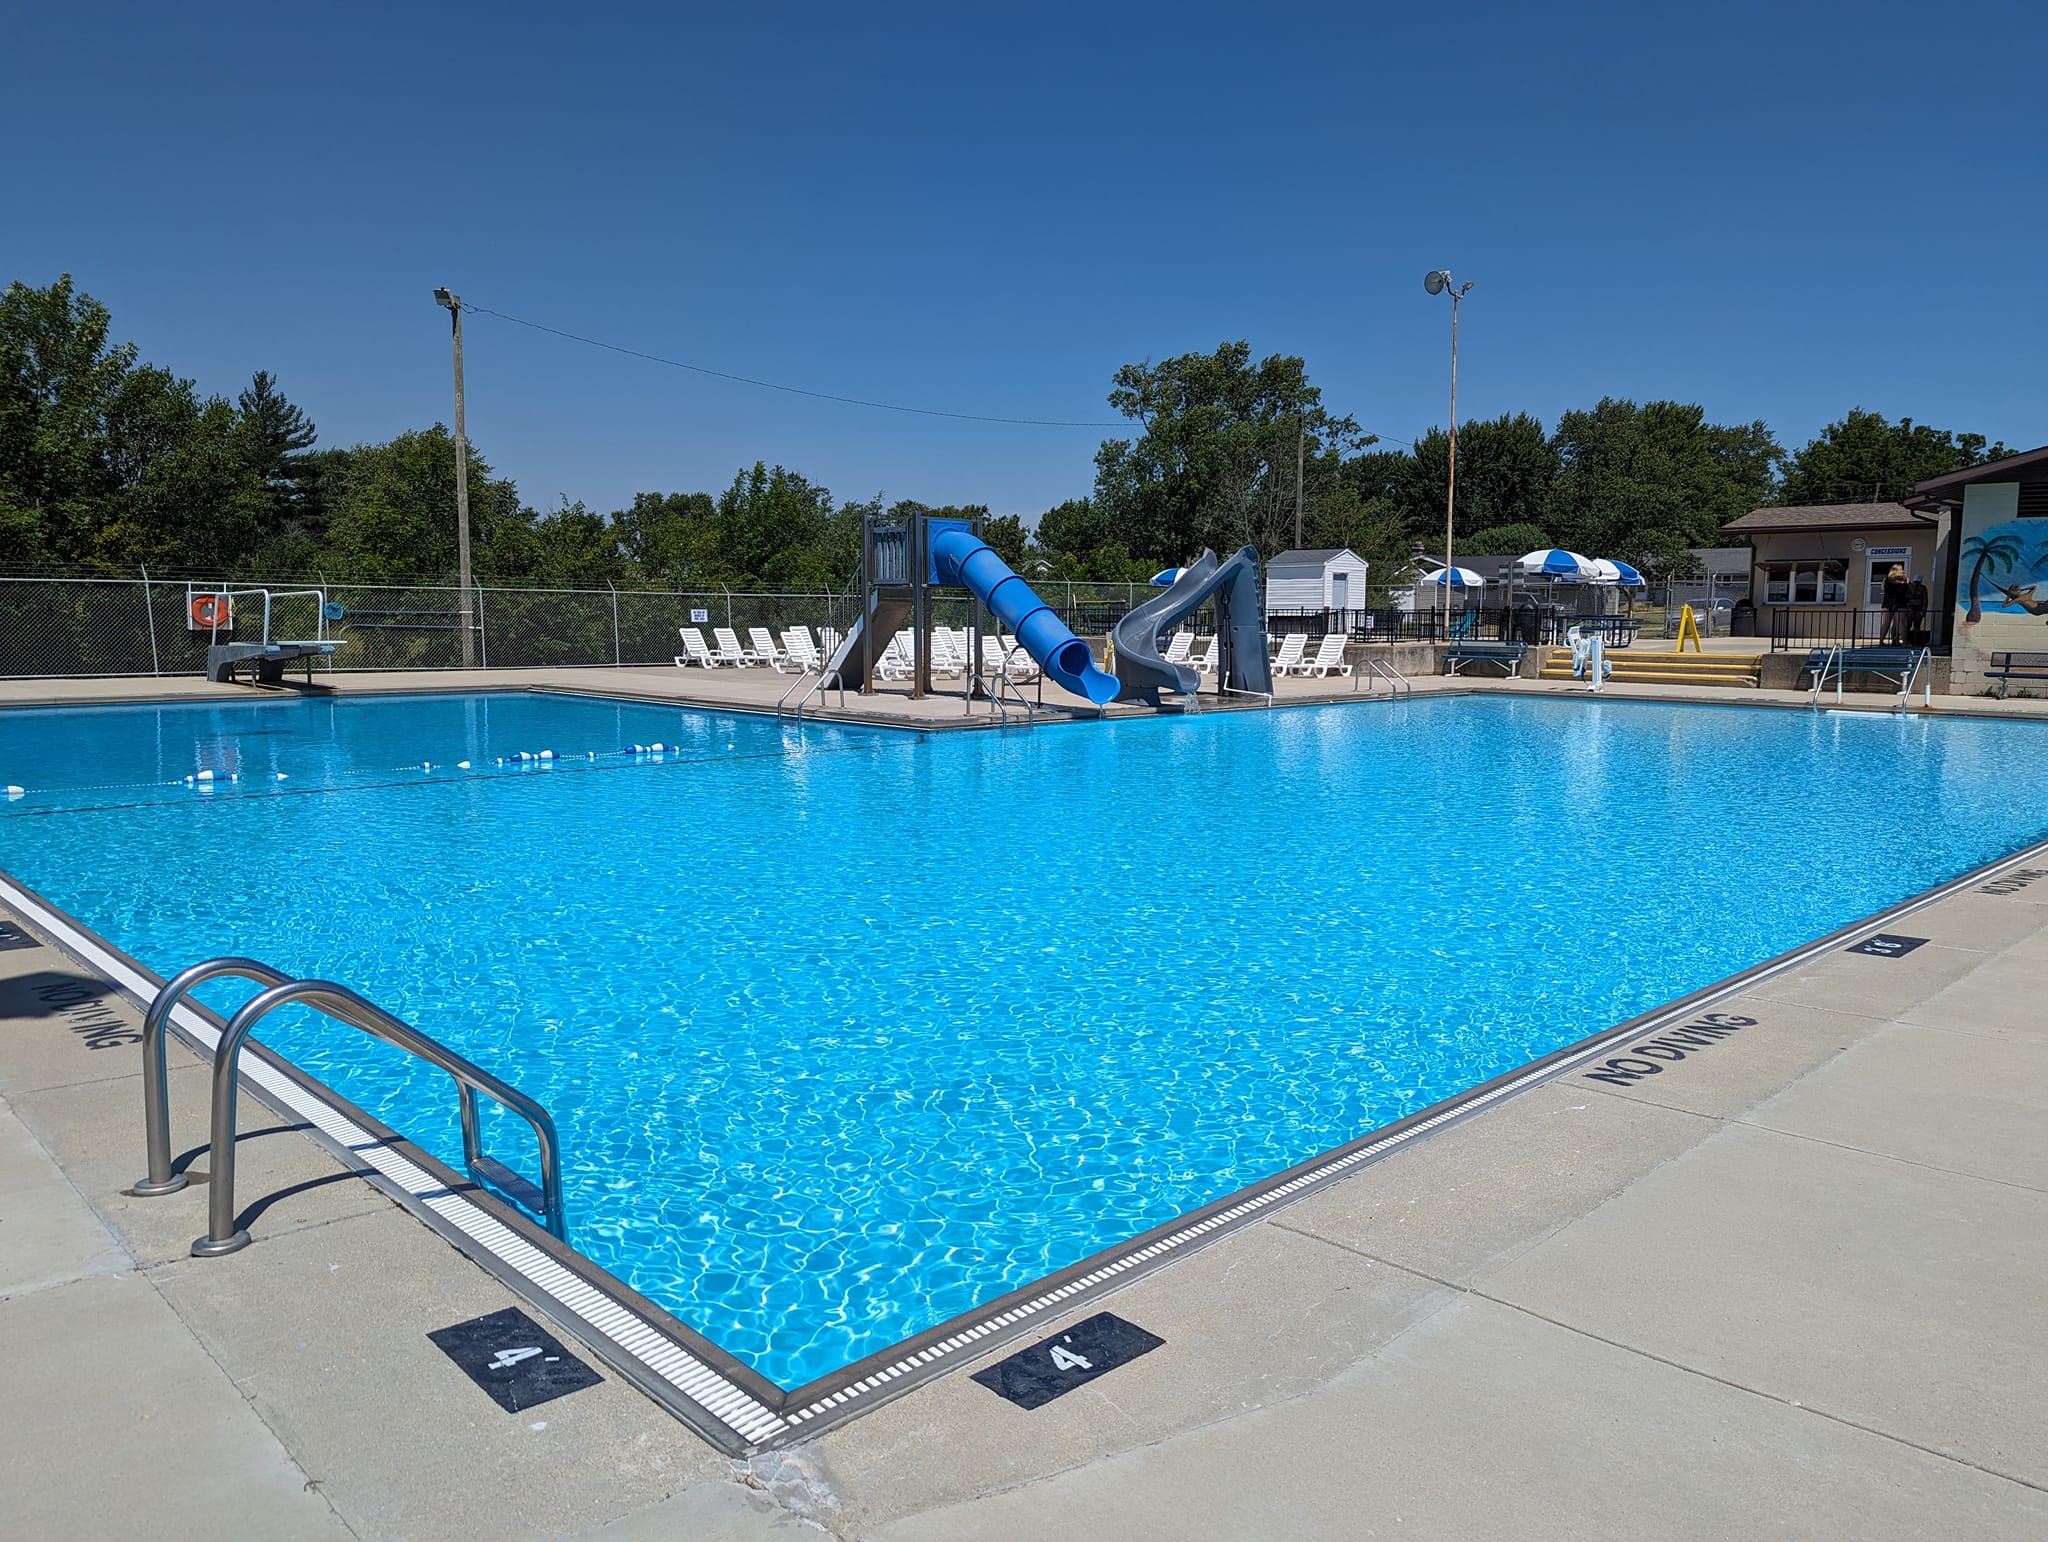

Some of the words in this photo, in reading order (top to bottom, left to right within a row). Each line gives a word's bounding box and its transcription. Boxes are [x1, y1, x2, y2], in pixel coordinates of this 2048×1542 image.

[1972, 885, 2020, 896] NO
[30, 982, 94, 1002] NO
[51, 1000, 144, 1051] DIVING
[1582, 1058, 1664, 1087] NO
[1631, 1013, 1759, 1061] DIVING
